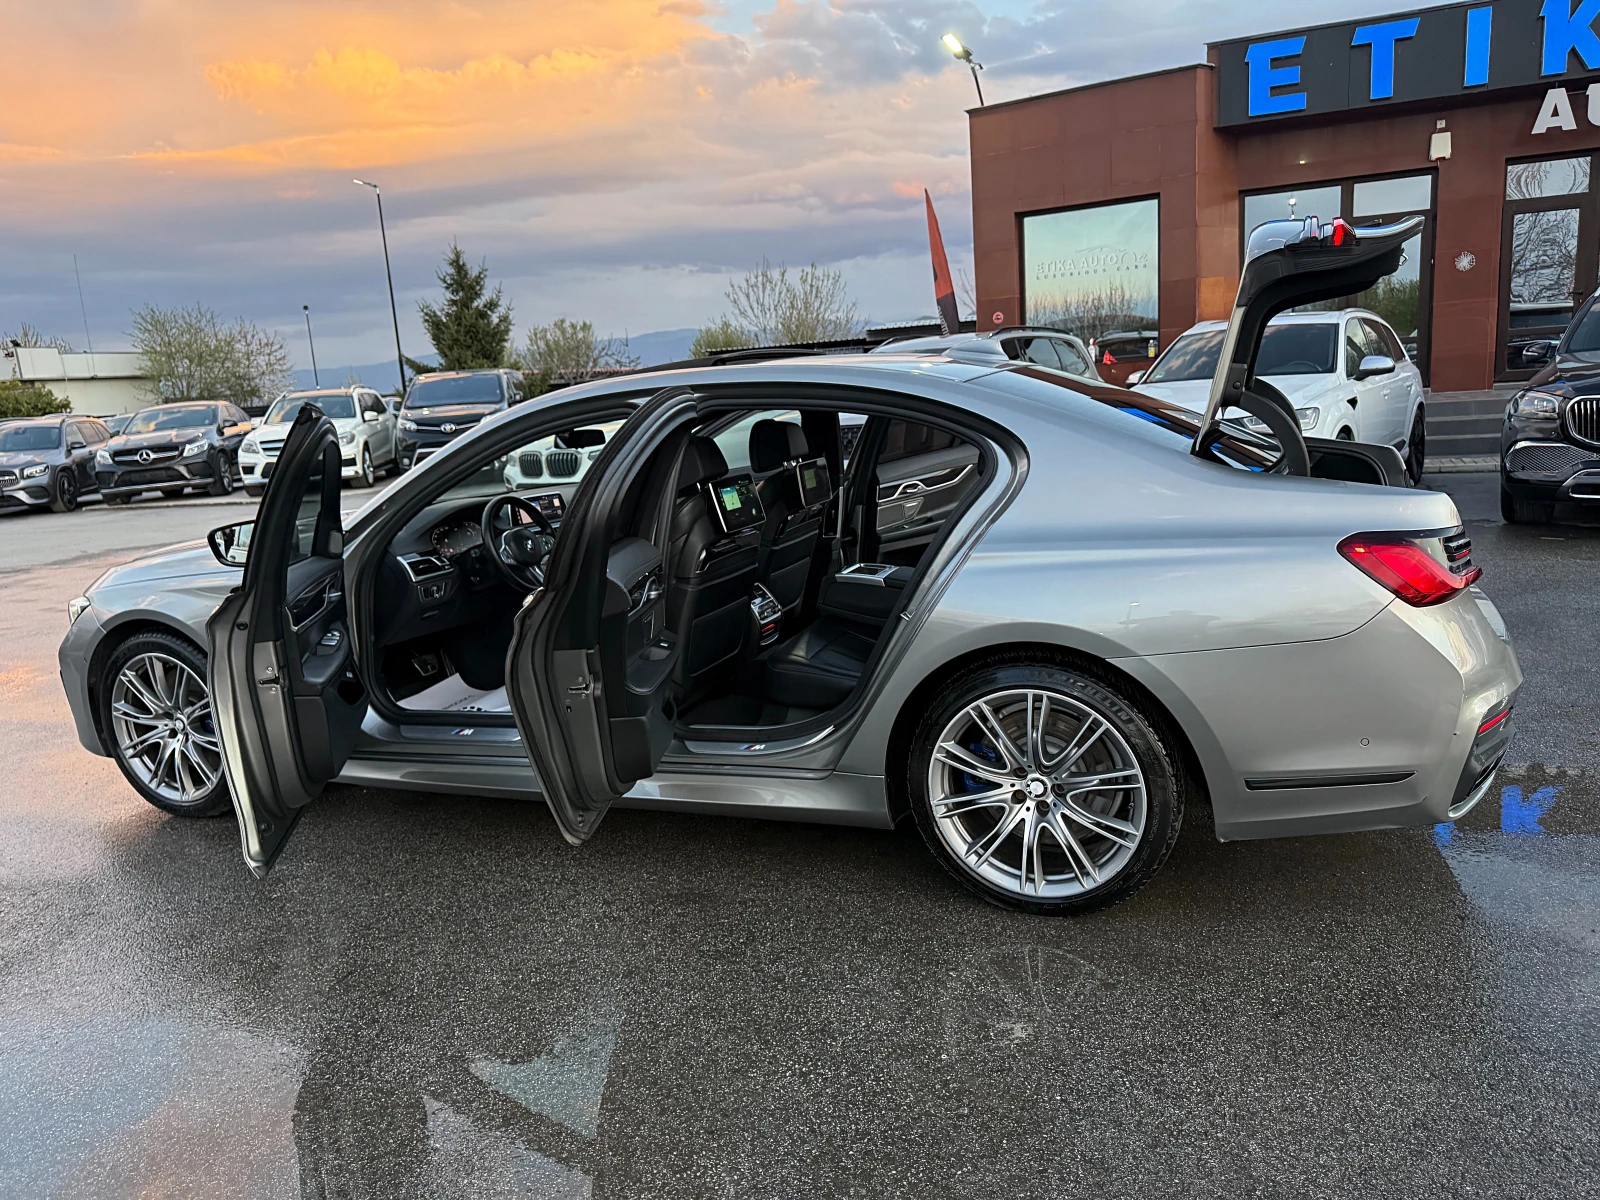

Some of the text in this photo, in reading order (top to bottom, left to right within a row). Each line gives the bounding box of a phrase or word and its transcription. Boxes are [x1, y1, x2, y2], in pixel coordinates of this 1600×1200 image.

[1245, 0, 1600, 117] ETIK
[1036, 252, 1118, 275] ETIKA AUTO
[1036, 263, 1148, 281] LUXURIOUS CARS
